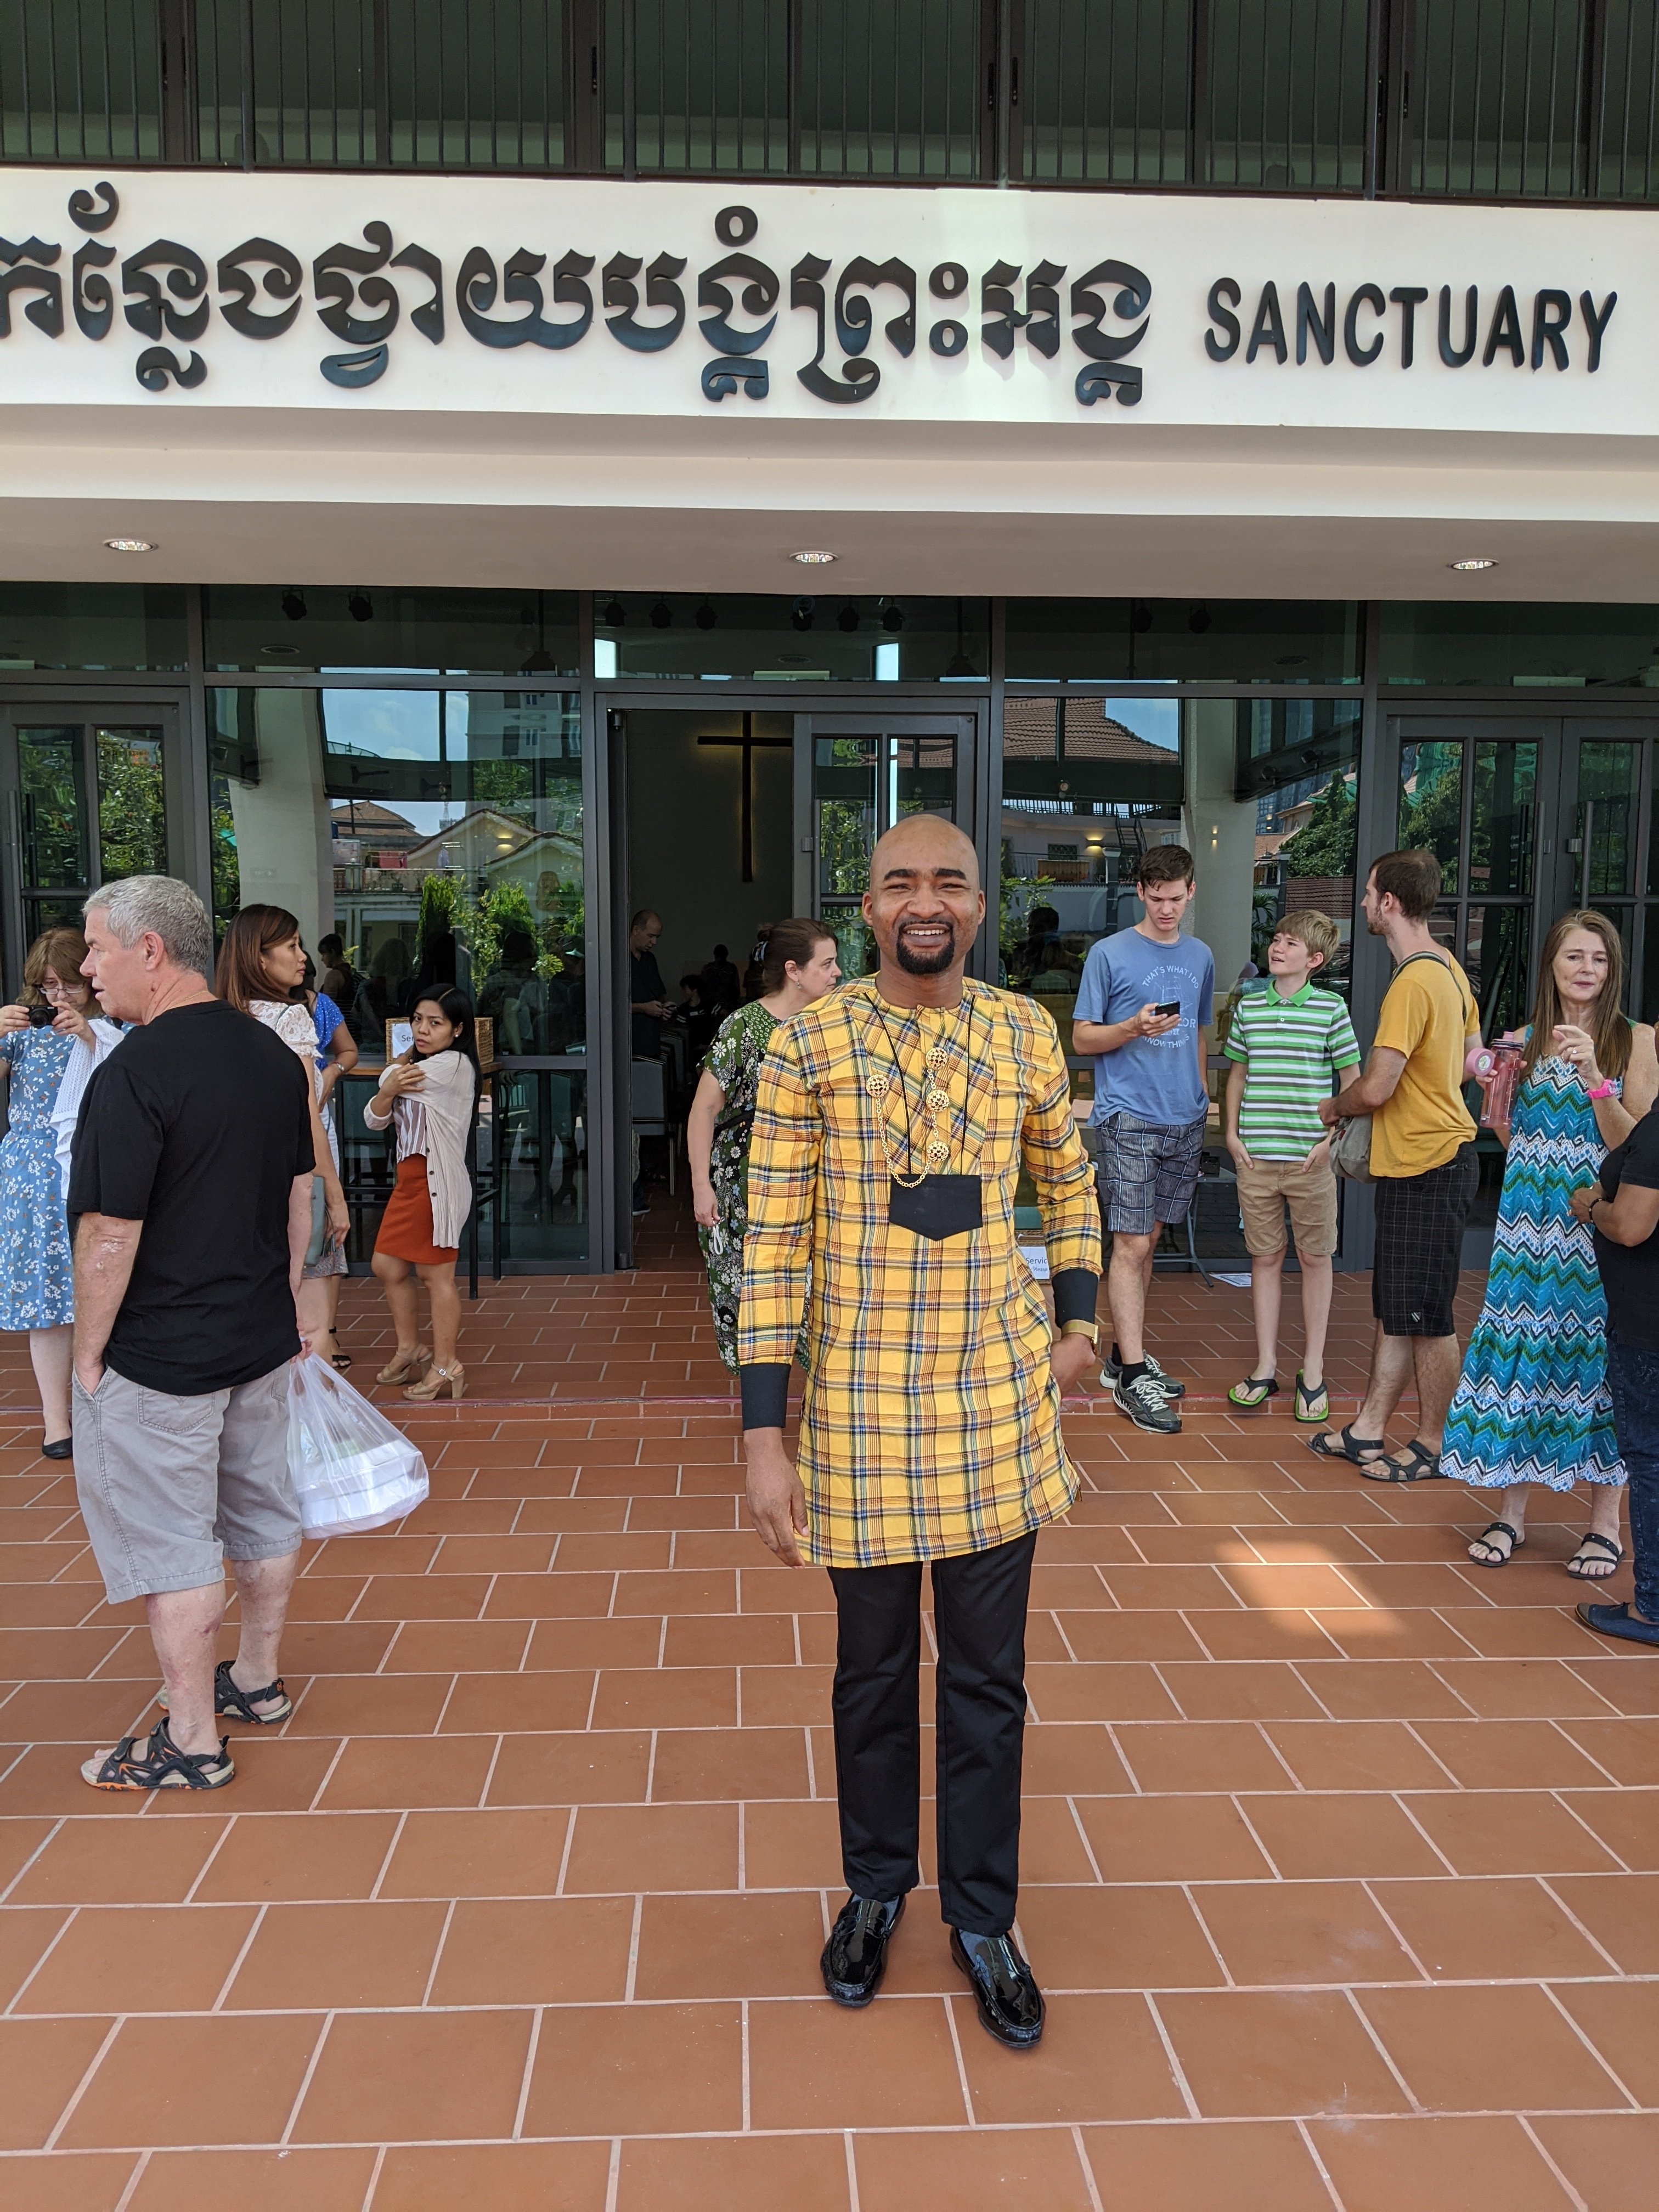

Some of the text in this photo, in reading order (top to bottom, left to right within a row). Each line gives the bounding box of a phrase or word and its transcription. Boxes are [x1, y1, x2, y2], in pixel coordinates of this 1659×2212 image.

[1205, 276, 1618, 374] SANCTUARY
[1142, 966, 1165, 986] THAT'S
[1166, 965, 1189, 976] WHAT
[1191, 977, 1199, 989] DO
